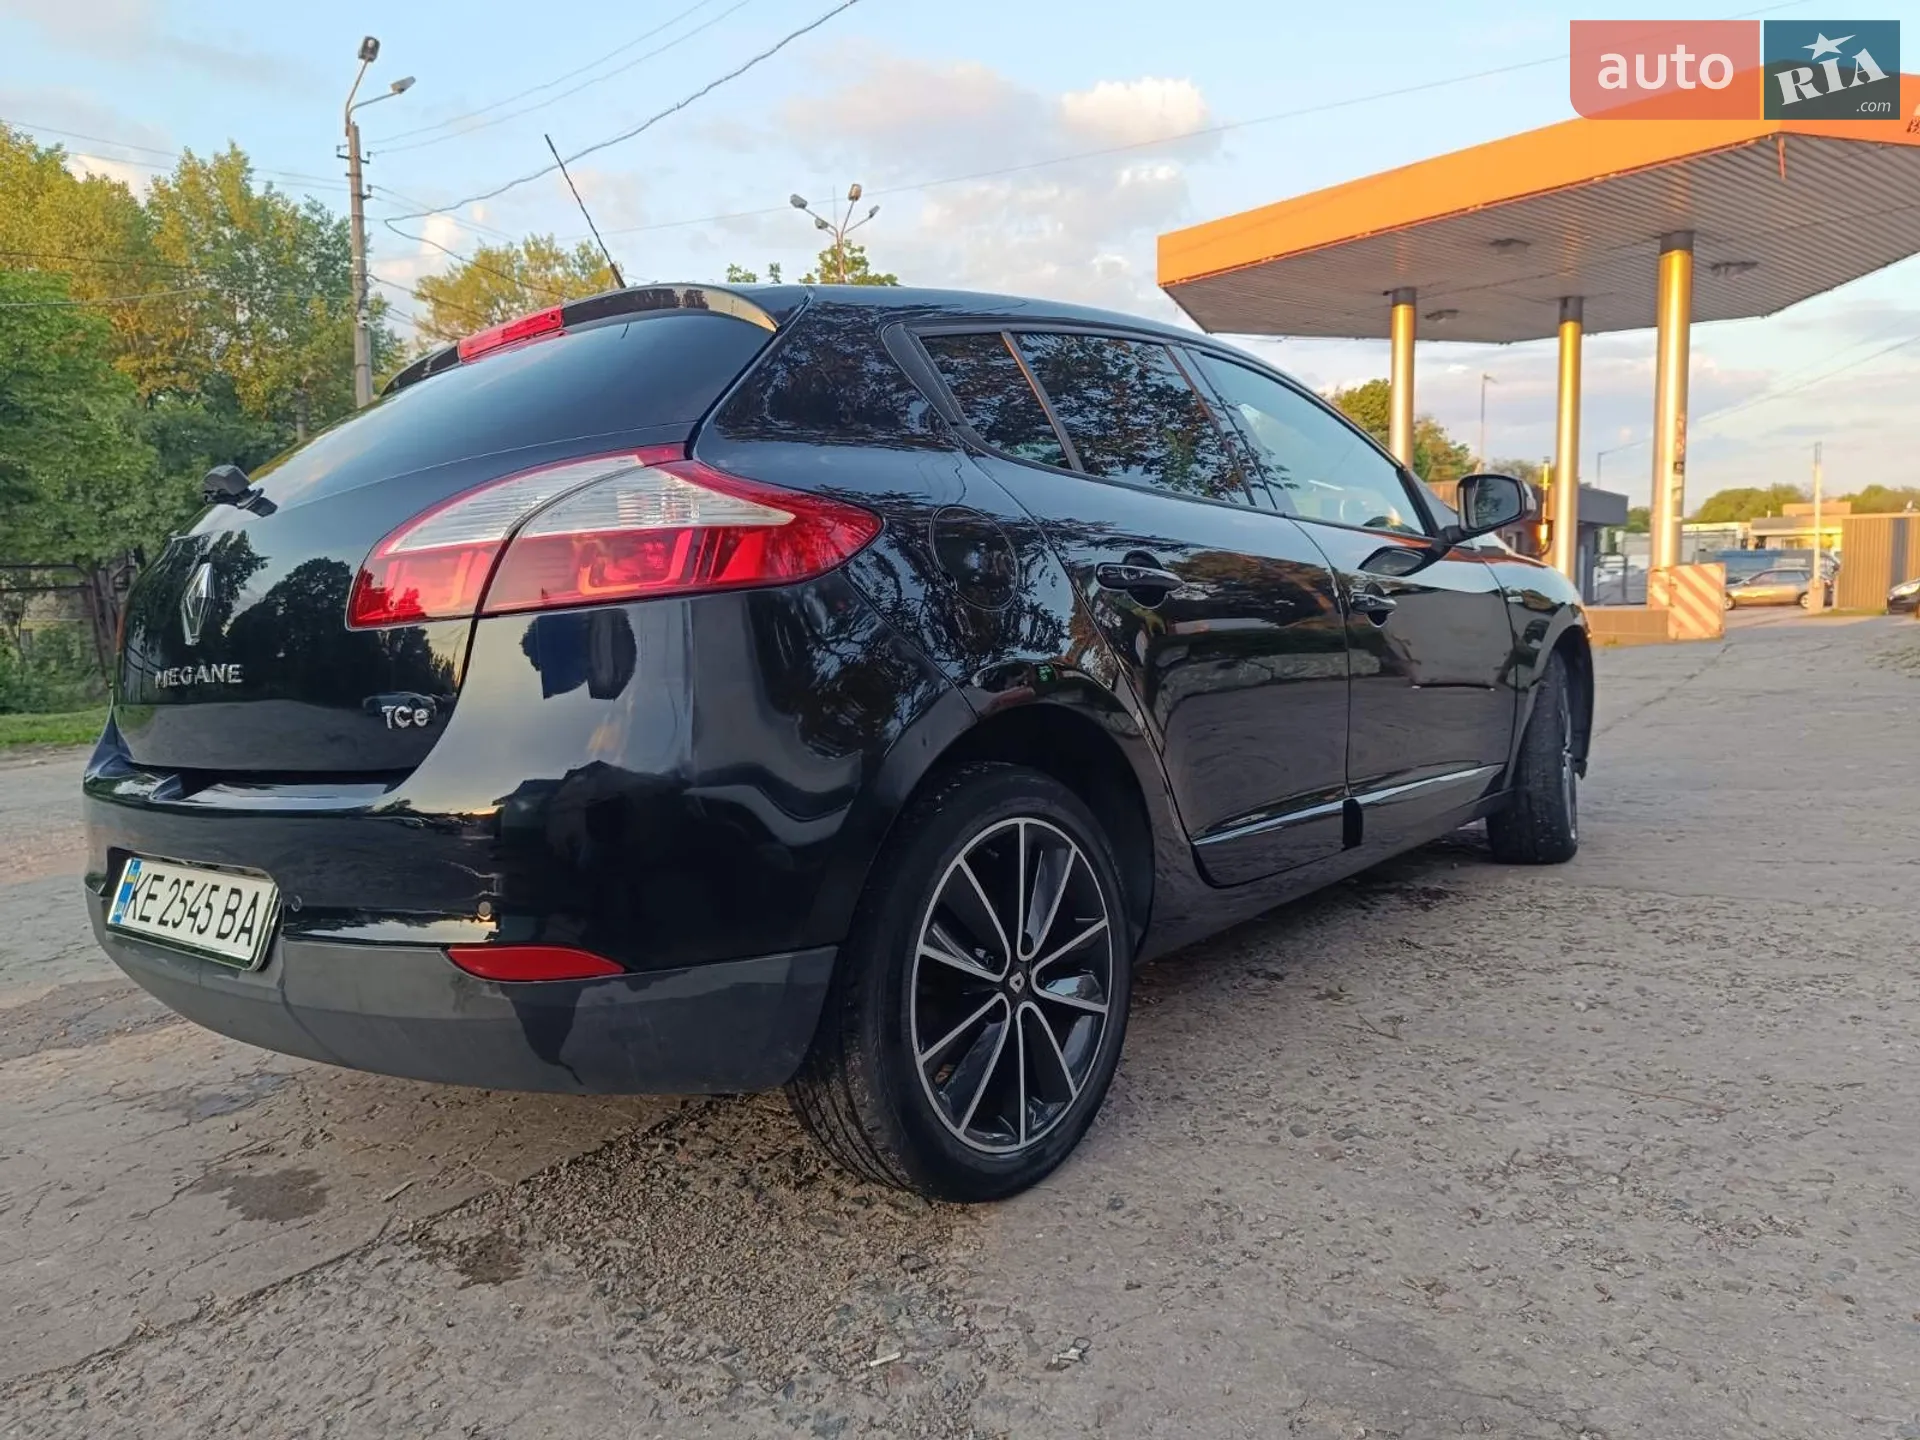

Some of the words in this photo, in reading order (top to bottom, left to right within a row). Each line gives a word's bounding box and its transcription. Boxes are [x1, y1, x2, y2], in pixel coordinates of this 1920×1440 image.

[154, 663, 244, 689] MEGANE
[124, 873, 165, 923] KE
[157, 878, 221, 936] 2545
[215, 887, 260, 947] BA
